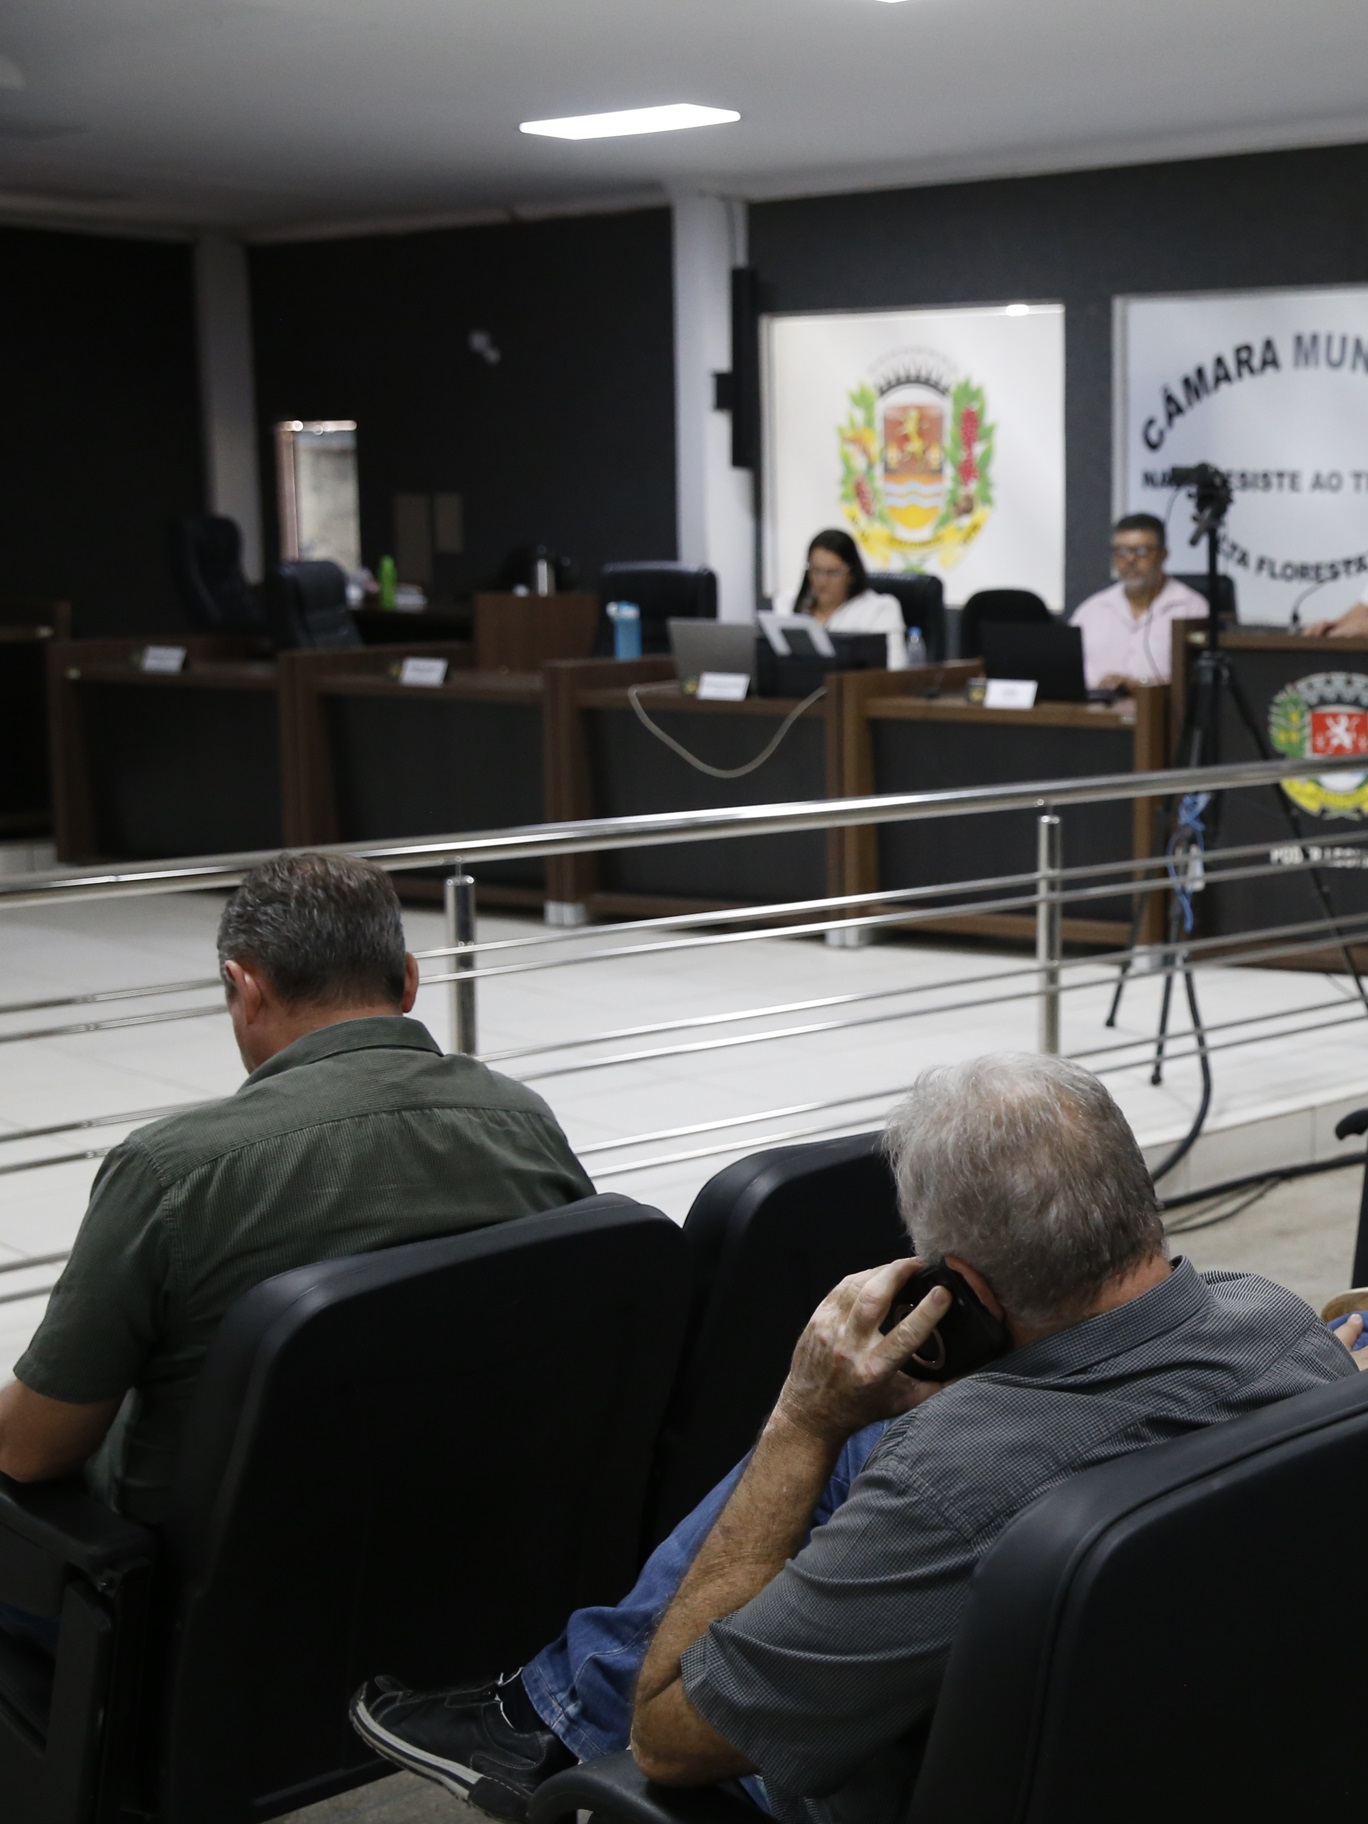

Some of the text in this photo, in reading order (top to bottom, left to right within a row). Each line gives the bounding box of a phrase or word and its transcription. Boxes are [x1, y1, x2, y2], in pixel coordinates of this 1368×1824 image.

[1143, 336, 1281, 453] CÂMARA
[1310, 470, 1343, 493] AO
[1255, 555, 1368, 584] FLORESTA
